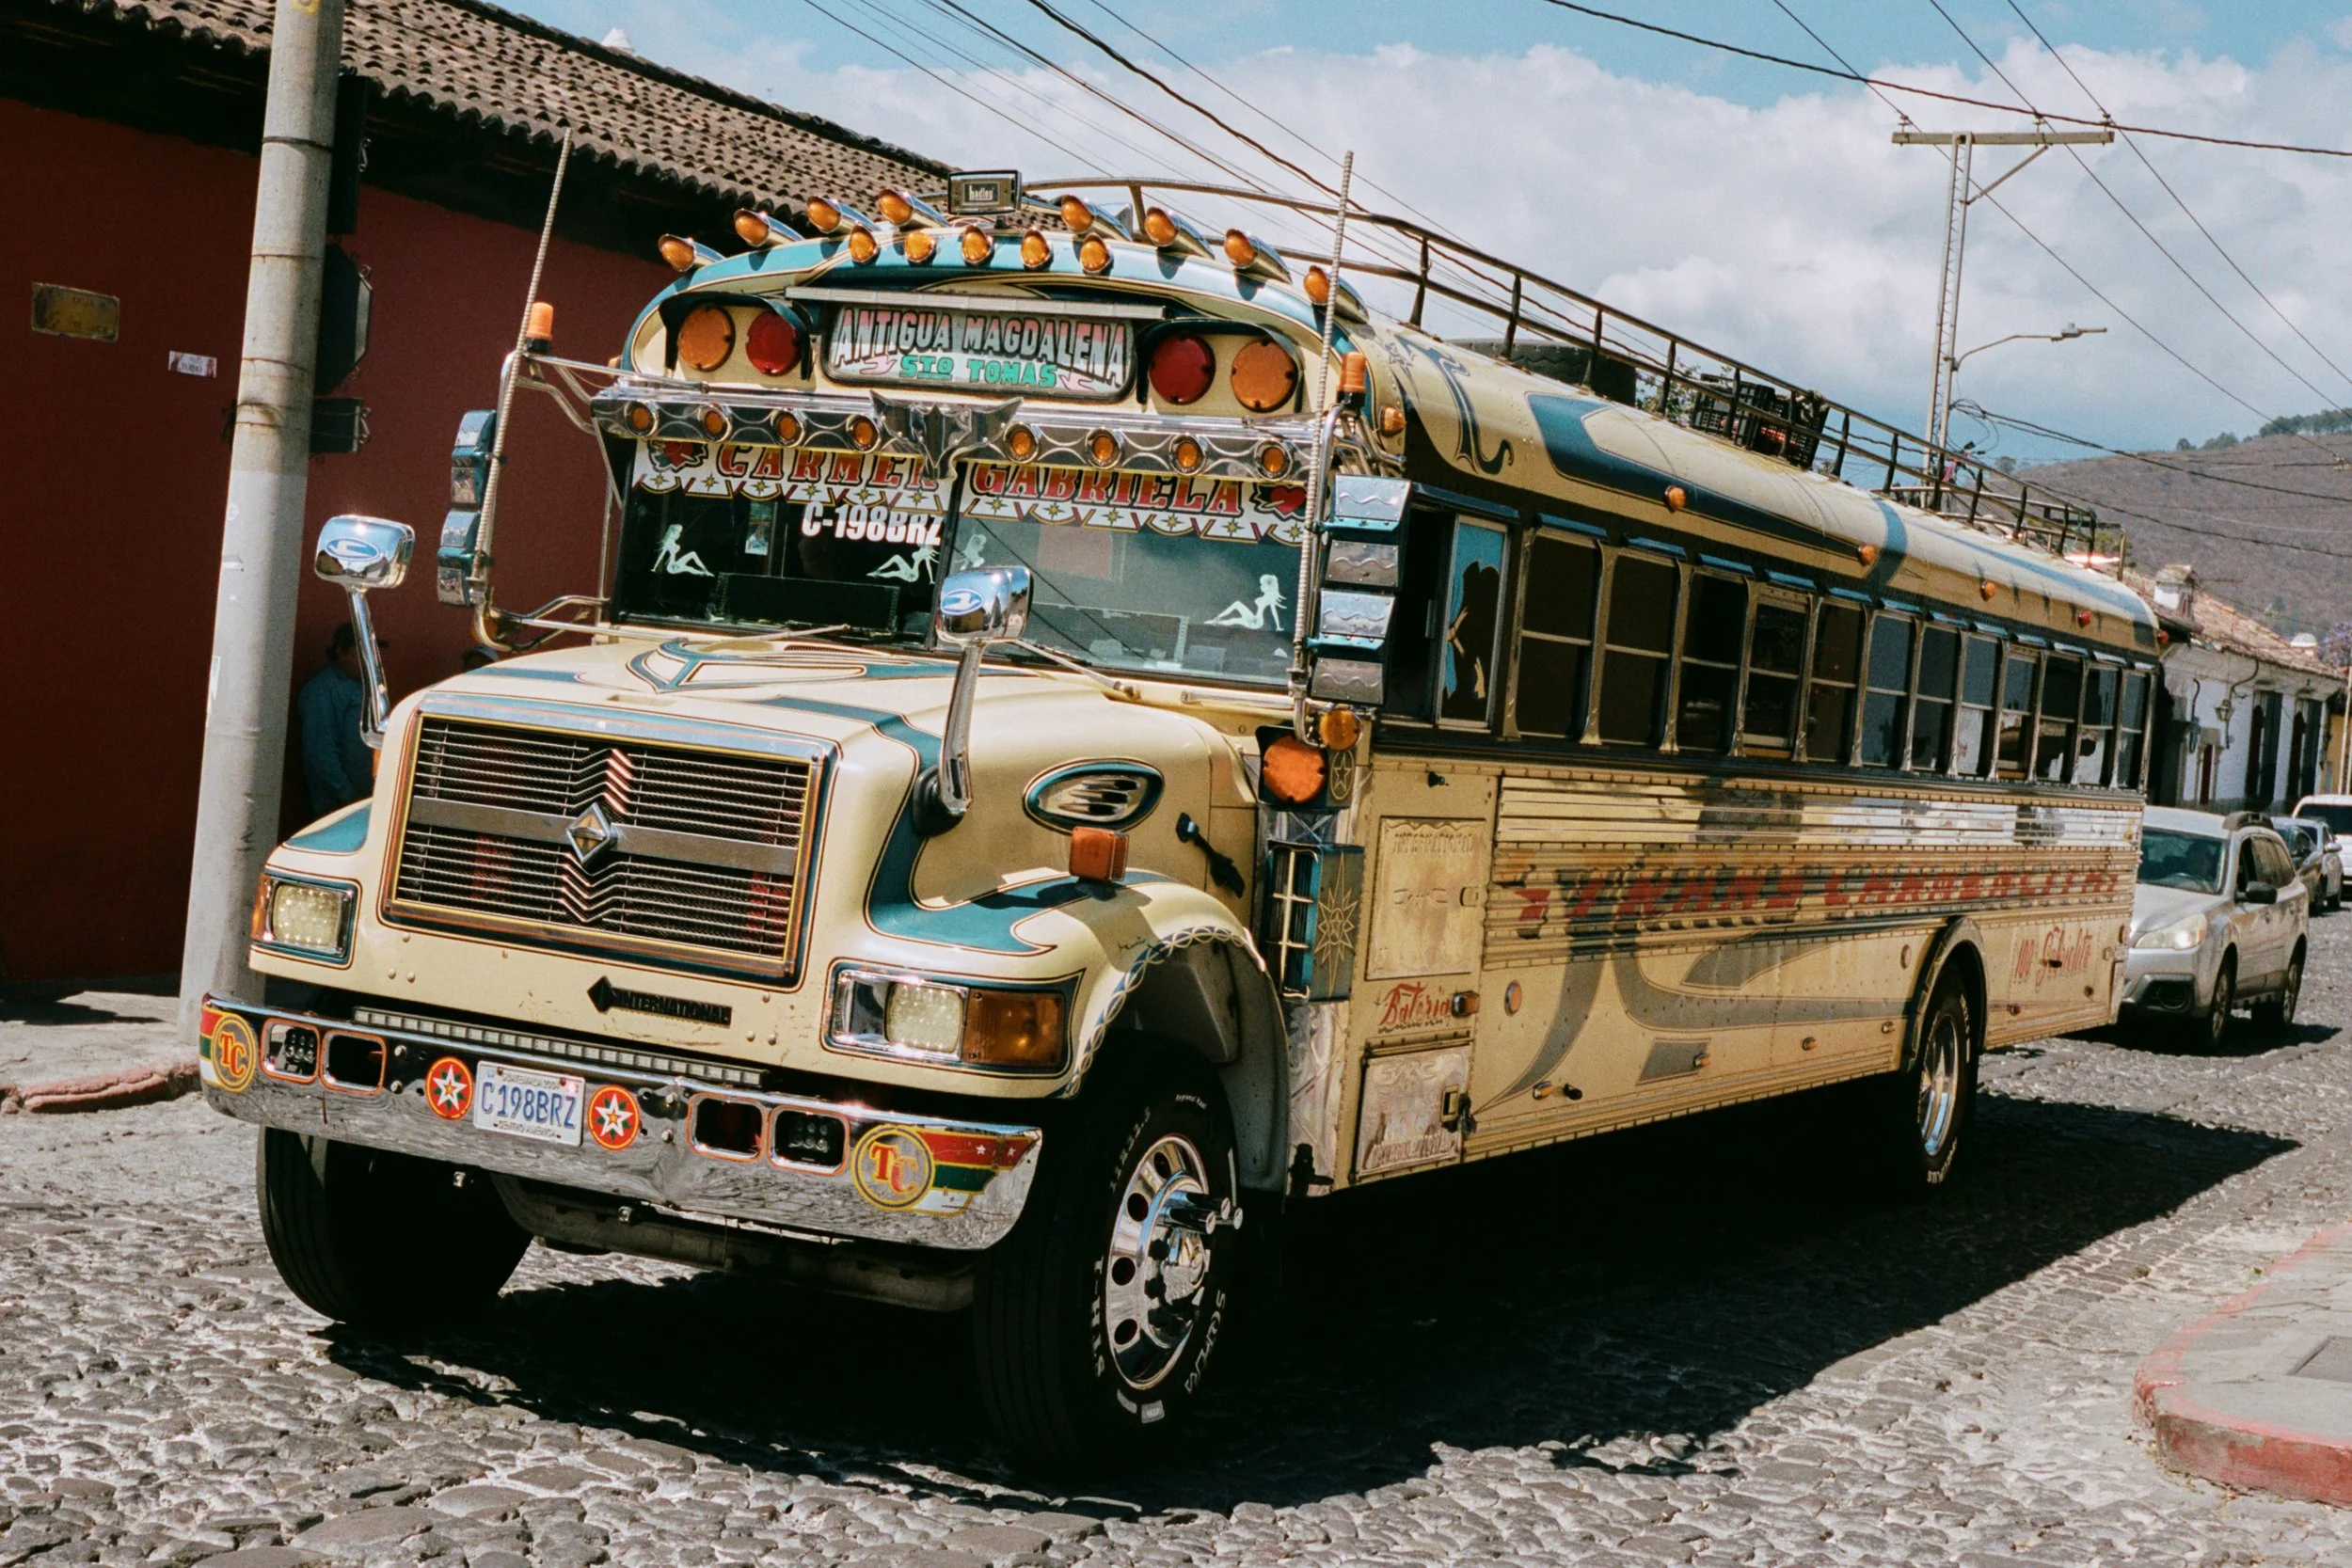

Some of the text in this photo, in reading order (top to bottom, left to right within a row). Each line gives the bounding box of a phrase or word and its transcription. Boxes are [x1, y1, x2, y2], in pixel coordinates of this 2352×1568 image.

[834, 308, 1127, 388] ANTIGUA MAGDALENA
[898, 355, 1058, 388] STO TOMAS
[970, 462, 1244, 516] GABRIELA
[802, 501, 942, 546] C-198BRZ
[611, 987, 732, 1025] INTERNATIONAL
[219, 1031, 247, 1078] TC
[869, 1141, 918, 1196] TC
